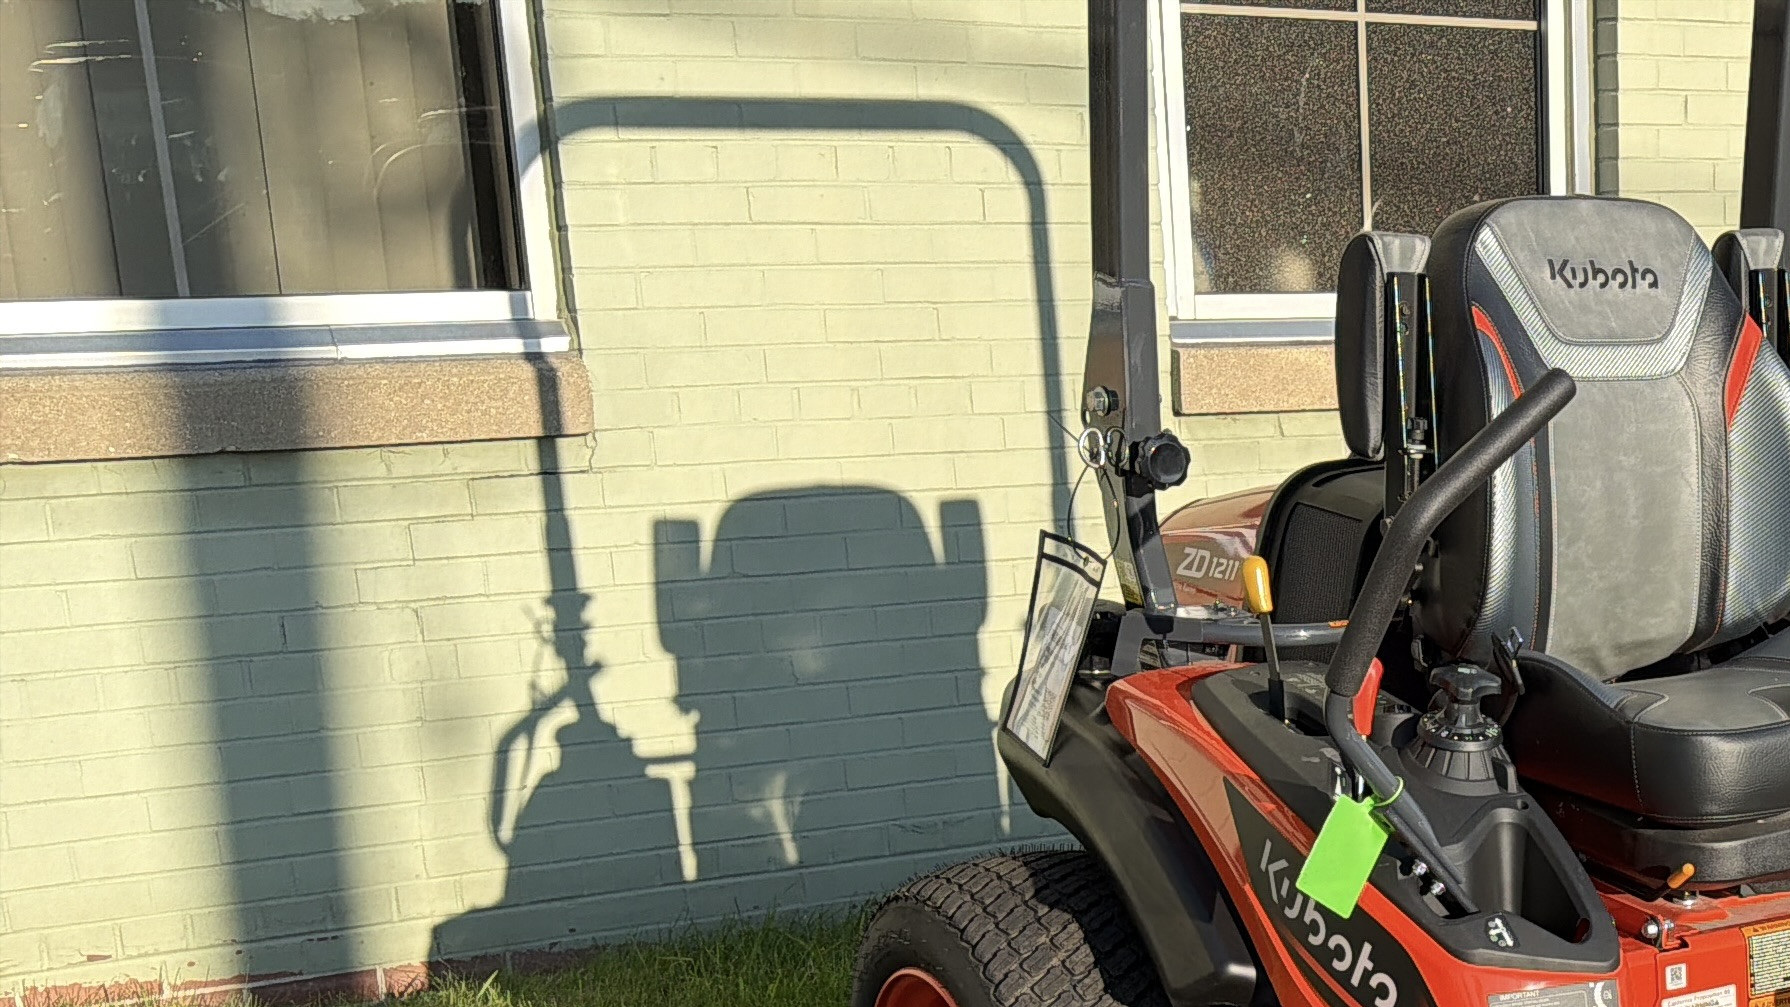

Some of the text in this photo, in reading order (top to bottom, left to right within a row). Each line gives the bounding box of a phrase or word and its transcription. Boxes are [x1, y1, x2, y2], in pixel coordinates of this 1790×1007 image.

[1547, 258, 1659, 290] Kubota
[1176, 546, 1240, 581] ZD1211
[1499, 990, 1540, 1001] IMPORTANT
